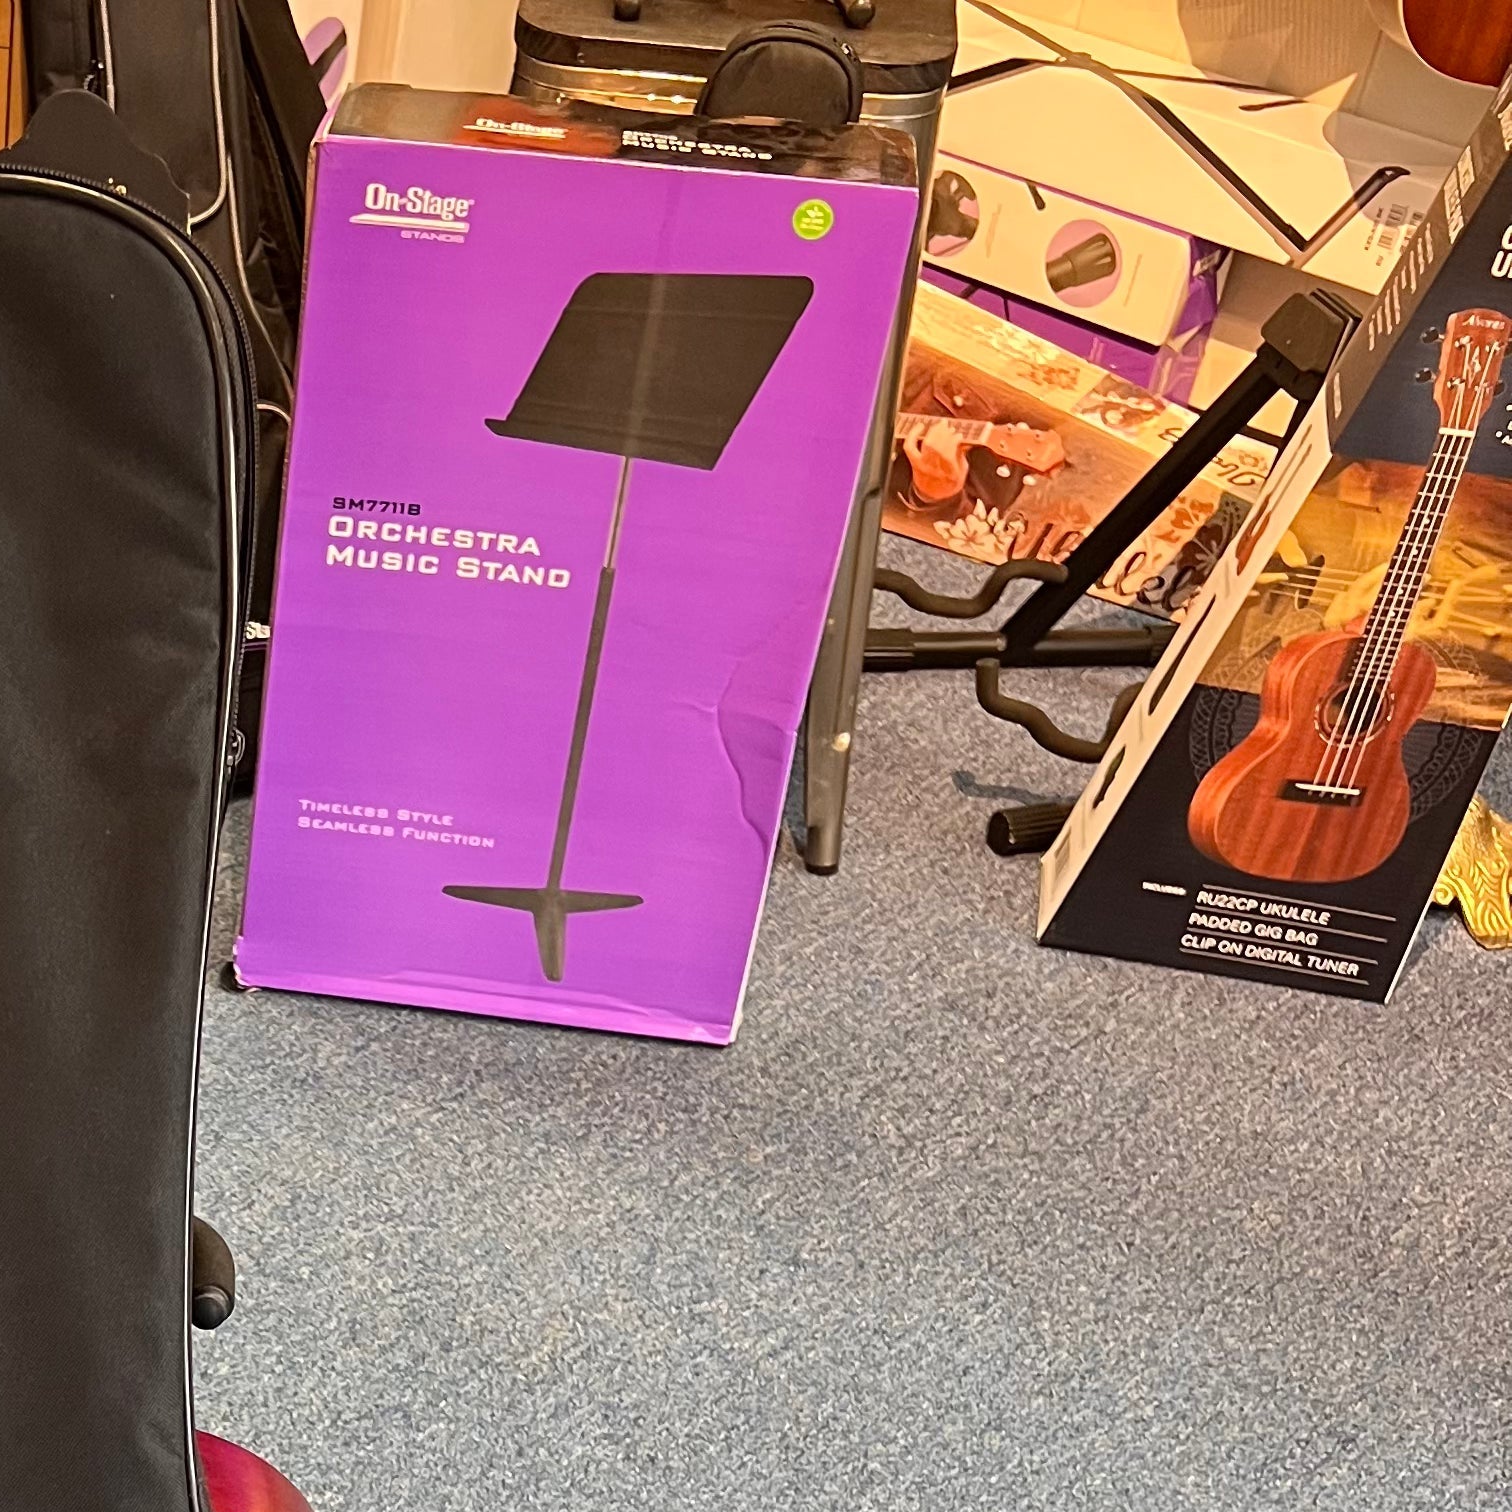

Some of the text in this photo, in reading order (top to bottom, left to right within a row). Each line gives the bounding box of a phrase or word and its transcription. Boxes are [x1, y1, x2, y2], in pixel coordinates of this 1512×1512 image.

[364, 183, 469, 220] On-Stage
[400, 230, 465, 243] STANDS
[332, 496, 422, 515] SM7711B
[327, 515, 541, 556] ORCHESTRA
[326, 544, 571, 588] MUSIC STAND
[1196, 890, 1331, 925] RU22CP UKULELE
[1188, 912, 1320, 946] PADDED GIG BAG
[1180, 934, 1360, 977] CLIP ON DIGITAL TUNER
